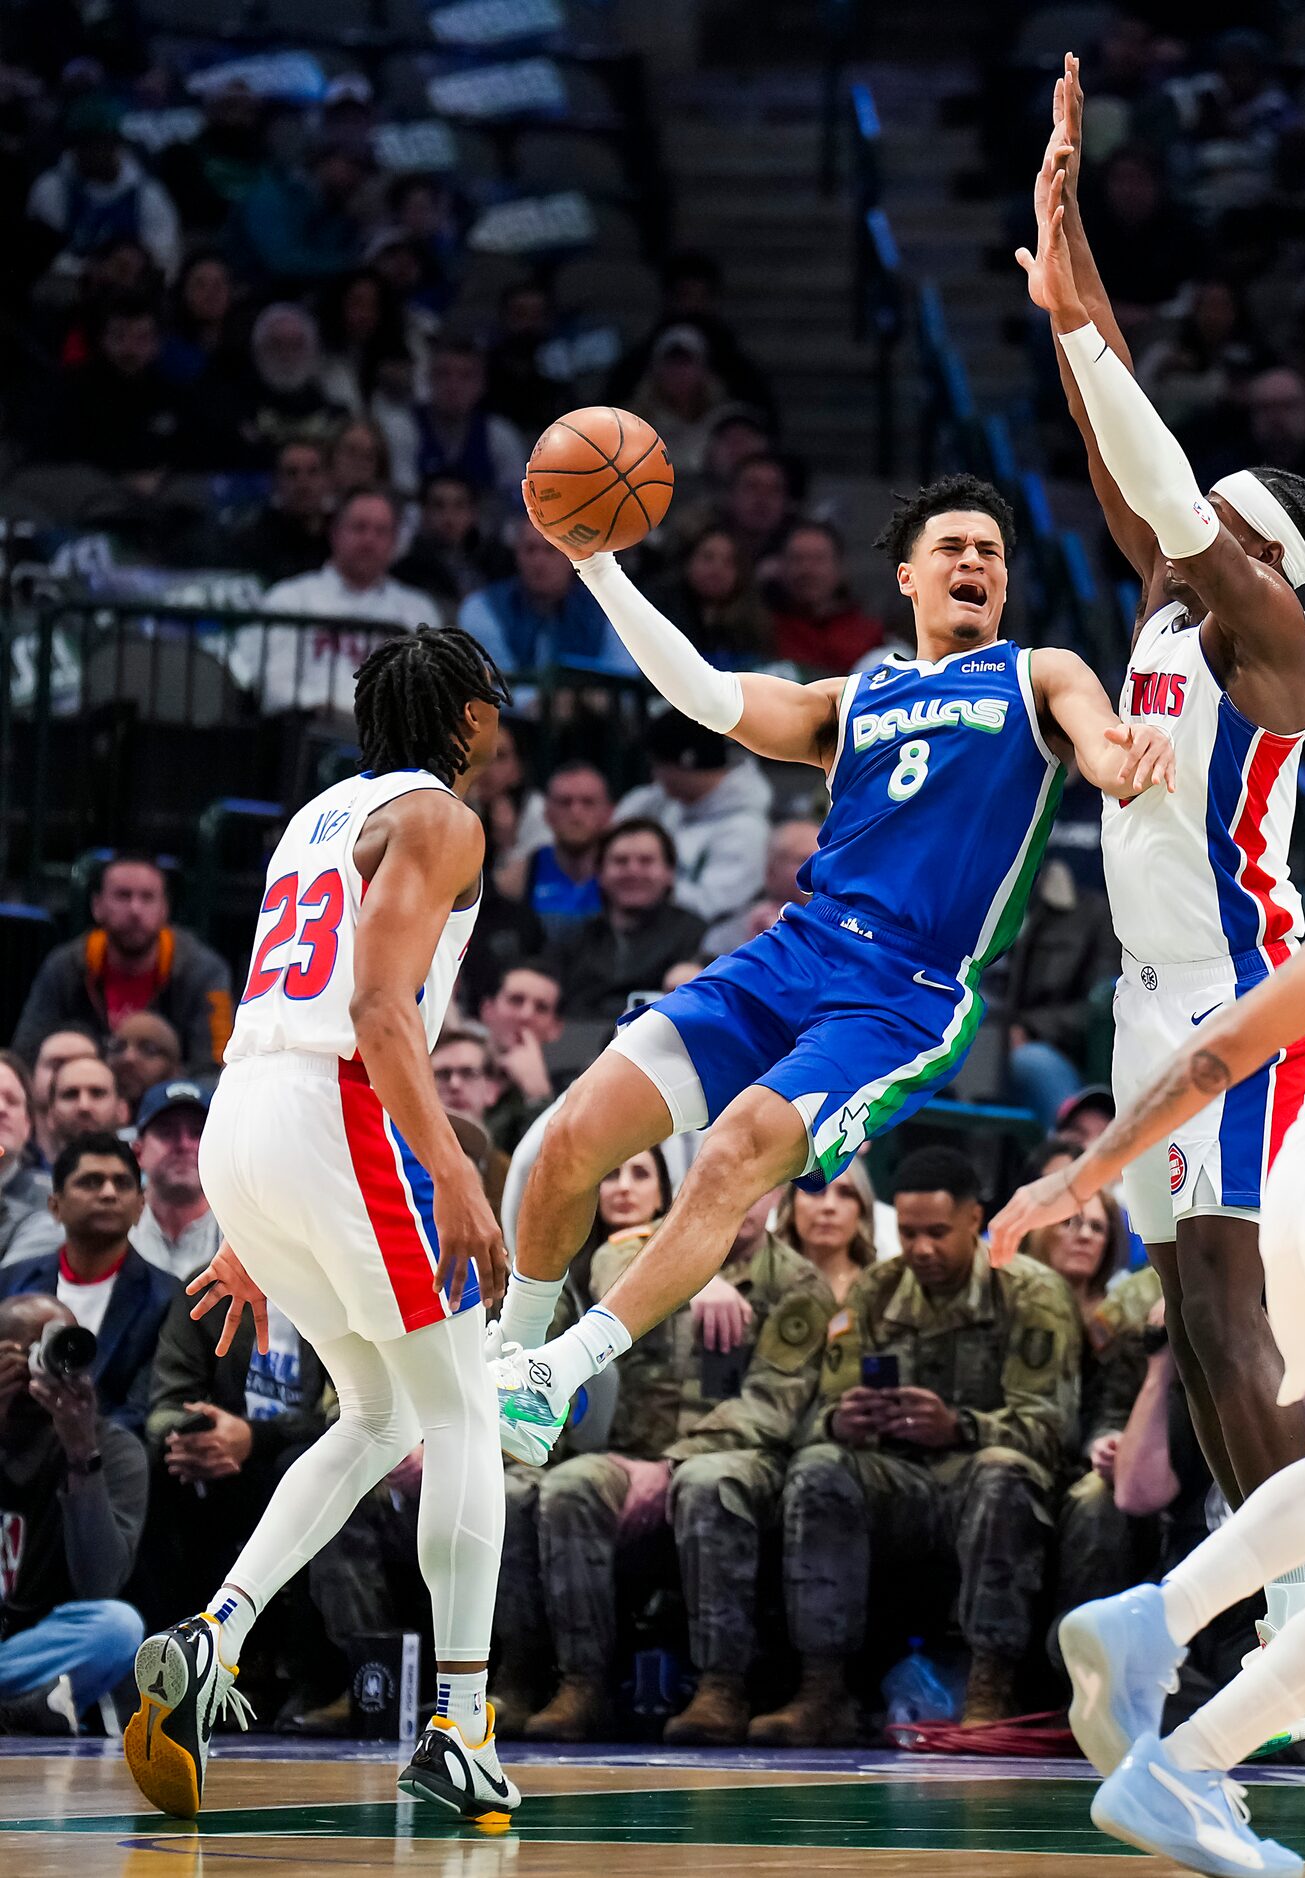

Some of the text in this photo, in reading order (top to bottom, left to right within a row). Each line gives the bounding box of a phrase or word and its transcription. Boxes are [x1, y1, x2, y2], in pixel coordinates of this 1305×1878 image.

[960, 660, 1006, 674] chime
[887, 739, 931, 802] 8
[239, 867, 345, 1005] 23
